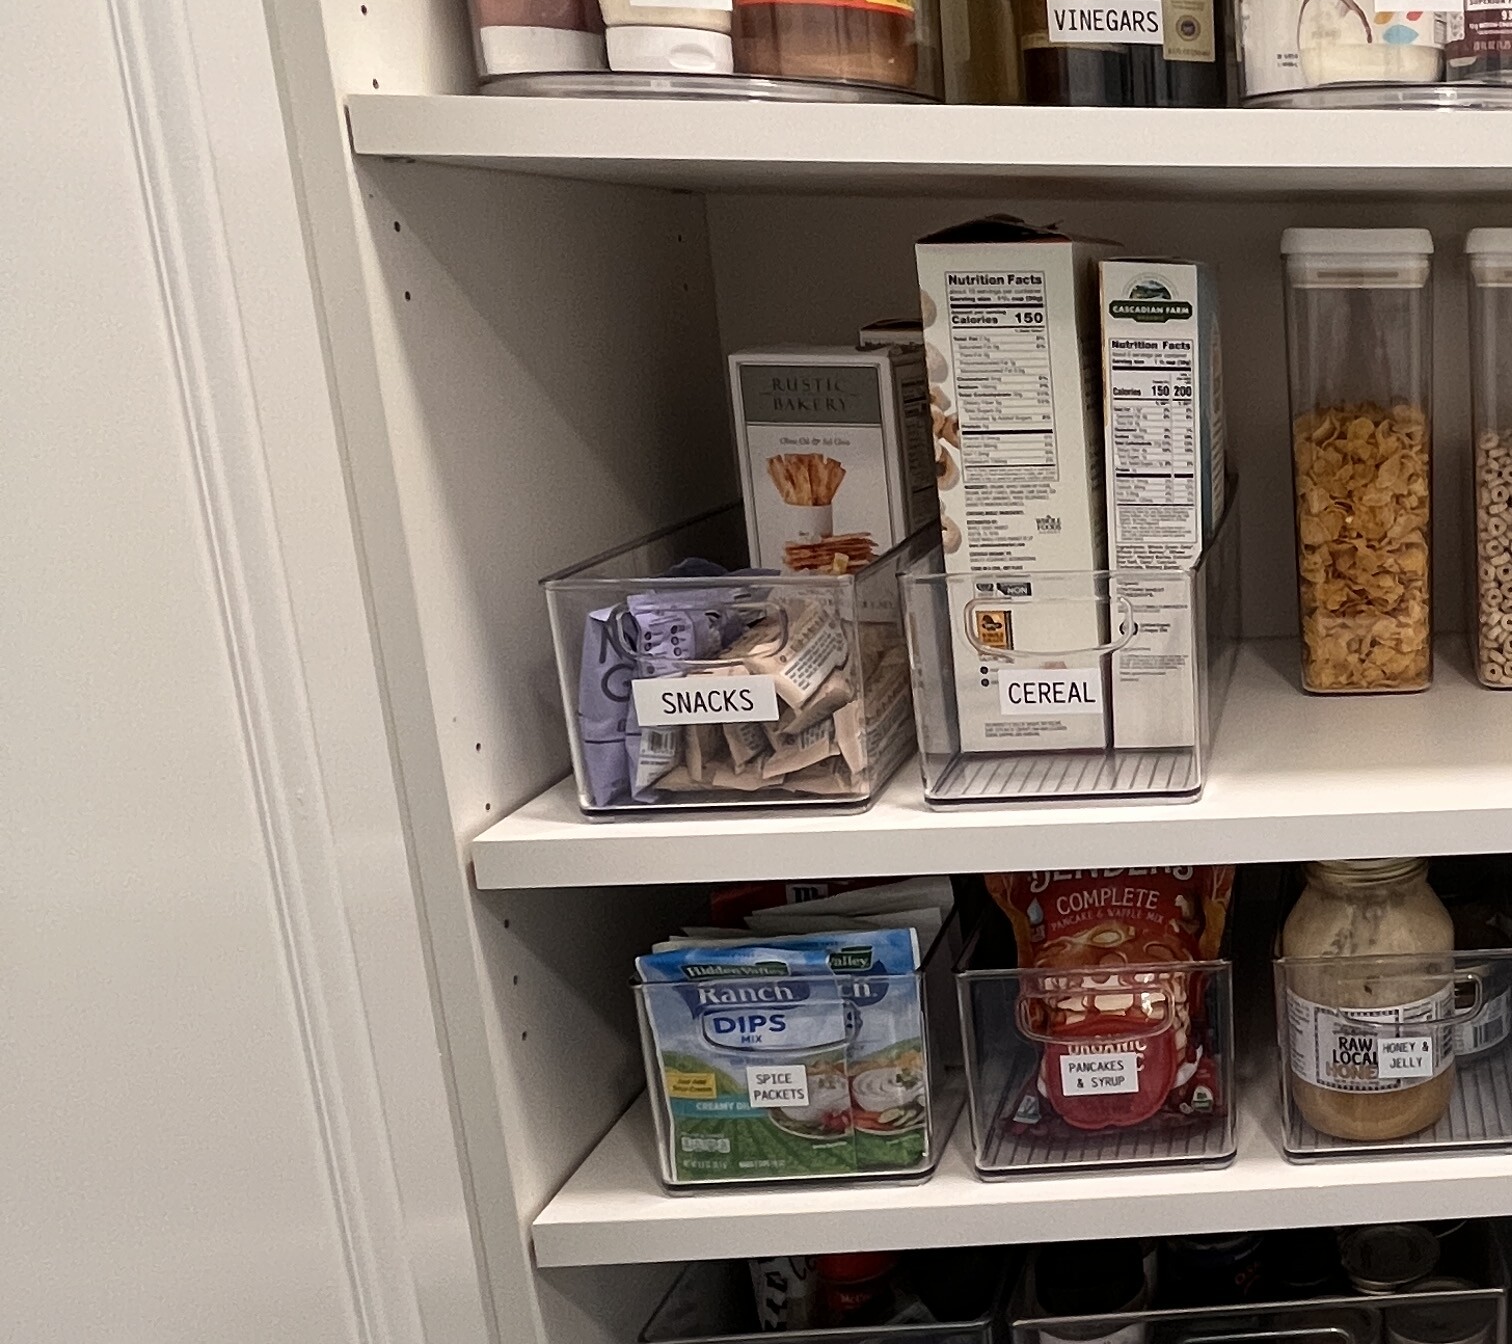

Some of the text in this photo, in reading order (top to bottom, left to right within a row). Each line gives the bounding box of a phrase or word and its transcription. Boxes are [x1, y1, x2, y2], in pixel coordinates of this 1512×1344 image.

[1054, 9, 1159, 33] VINEGARS
[948, 273, 1043, 285] Nutrition Facts
[1112, 305, 1189, 315] CASCADIAN FARM
[951, 312, 1044, 324] Calories 150
[1111, 340, 1191, 350] Nutrition Facts
[771, 376, 846, 393] RUSTIC
[1112, 385, 1192, 396] Calories 150 200
[773, 396, 847, 412] BAKERY
[1008, 681, 1096, 704] CEREAL
[661, 688, 754, 714] SNACKS
[1056, 887, 1160, 916] COMPLETE
[1050, 909, 1096, 932] PANCAKE
[1107, 907, 1142, 919] WAFFLE
[698, 982, 793, 1005] Ranch
[713, 1014, 787, 1034] DIPS
[741, 1034, 762, 1044] MIX
[1338, 1036, 1373, 1052] RAW
[1383, 1041, 1429, 1053] HONEY &
[1332, 1049, 1379, 1066] LOCAL
[1389, 1057, 1422, 1069] JELLY
[1068, 1059, 1124, 1073] PANCAKES
[1326, 1061, 1378, 1079] HONE
[756, 1073, 793, 1085] SPICE
[1076, 1076, 1125, 1088] & SYRUP
[753, 1088, 805, 1102] PACKETS
